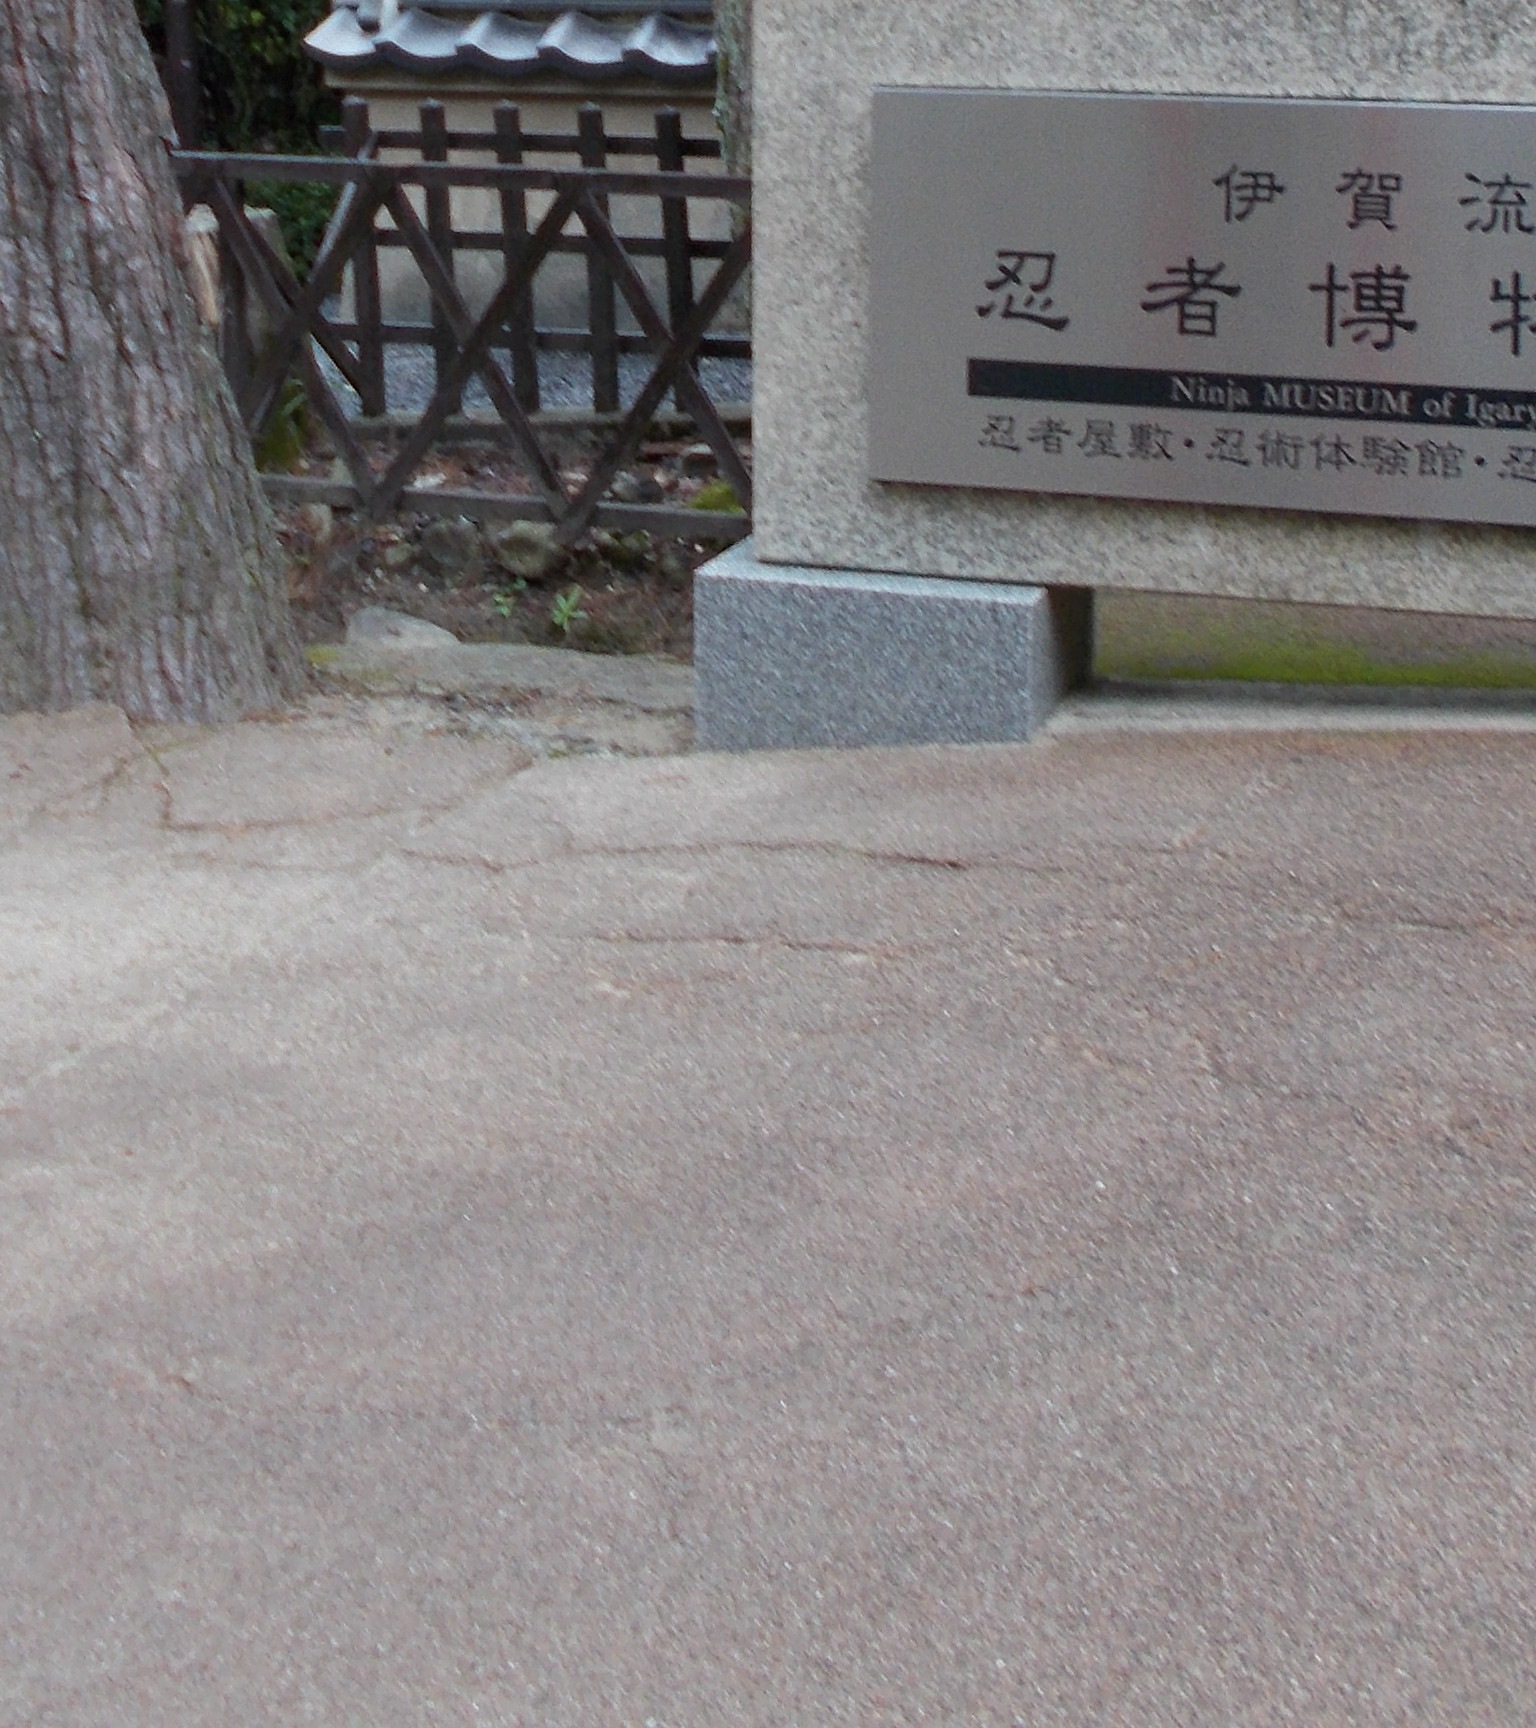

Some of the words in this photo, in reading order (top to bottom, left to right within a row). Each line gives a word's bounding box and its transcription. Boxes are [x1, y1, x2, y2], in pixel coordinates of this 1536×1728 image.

[1212, 164, 1536, 236] 伊賀流
[1168, 374, 1251, 412] Ninja
[1263, 382, 1412, 419] MUSEUM
[1421, 390, 1456, 419] of
